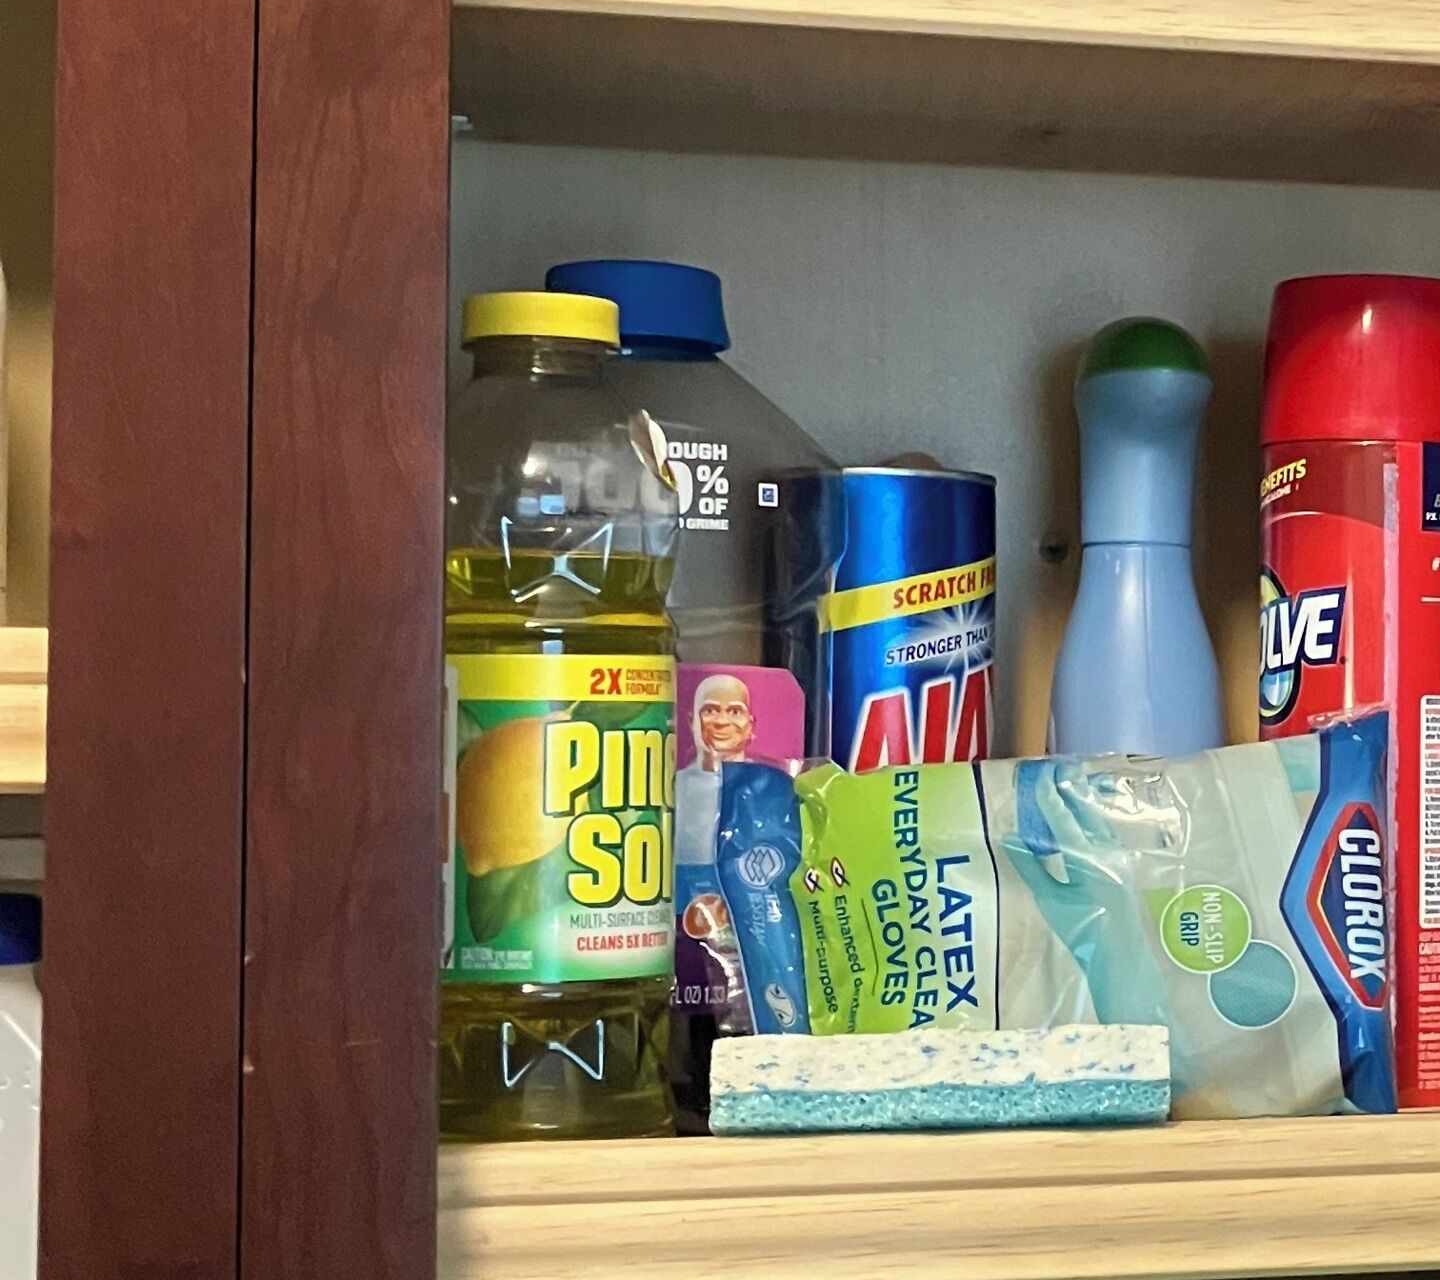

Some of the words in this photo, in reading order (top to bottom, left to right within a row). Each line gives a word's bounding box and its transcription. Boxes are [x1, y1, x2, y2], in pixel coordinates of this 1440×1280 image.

[667, 442, 728, 461] OUGH
[698, 497, 728, 515] OF
[892, 571, 976, 610] SCRATCH
[886, 635, 962, 666] STRONGER
[590, 668, 622, 695] 2X
[894, 770, 932, 934] EVERYDAY
[1338, 828, 1386, 984] CLOROX
[577, 935, 624, 951] CLEANS
[834, 895, 866, 973] Enhanced
[871, 879, 908, 1006] GLOVES
[936, 855, 978, 1012] LATEX
[1180, 911, 1199, 947] GRIP
[1202, 891, 1225, 964] NON-SLIP
